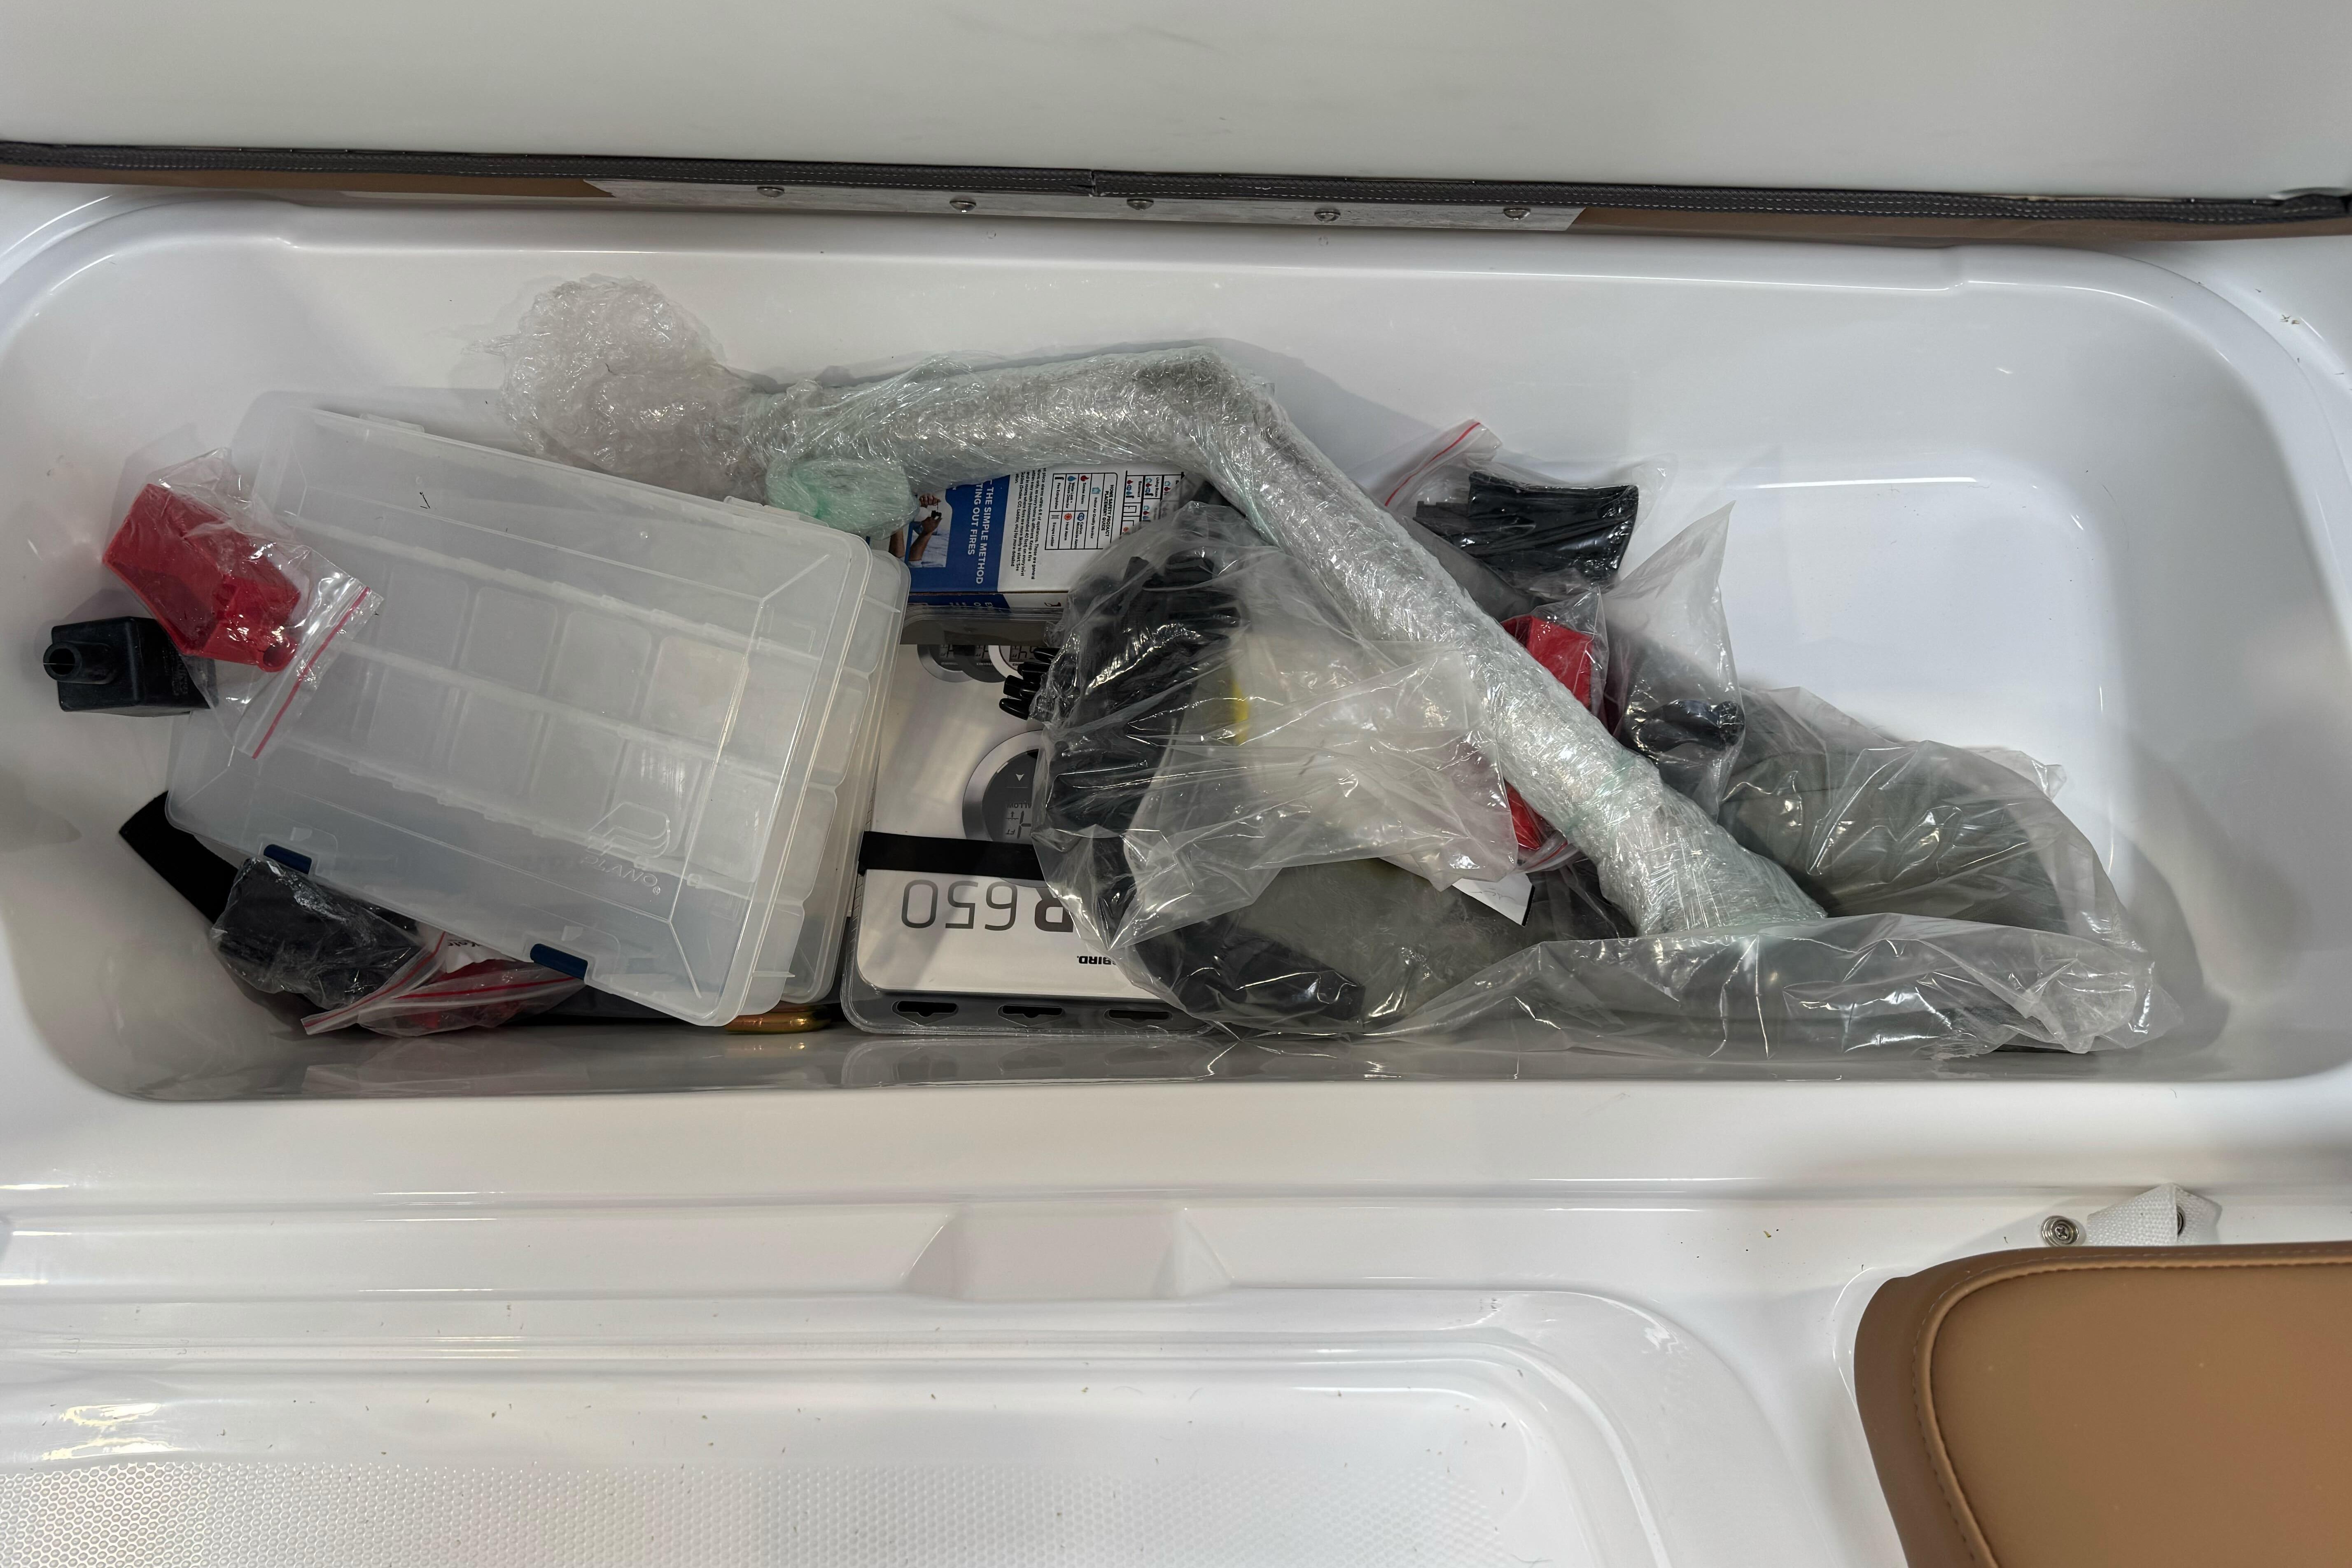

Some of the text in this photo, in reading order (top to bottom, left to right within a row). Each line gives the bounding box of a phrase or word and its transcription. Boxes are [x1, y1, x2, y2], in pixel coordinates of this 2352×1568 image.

[971, 507, 980, 527] OUT
[968, 529, 978, 555] FIRES
[976, 487, 994, 584] THE SIMPLE METHOD
[901, 880, 1017, 931] 650
[1077, 956, 1116, 965] BIRD.
